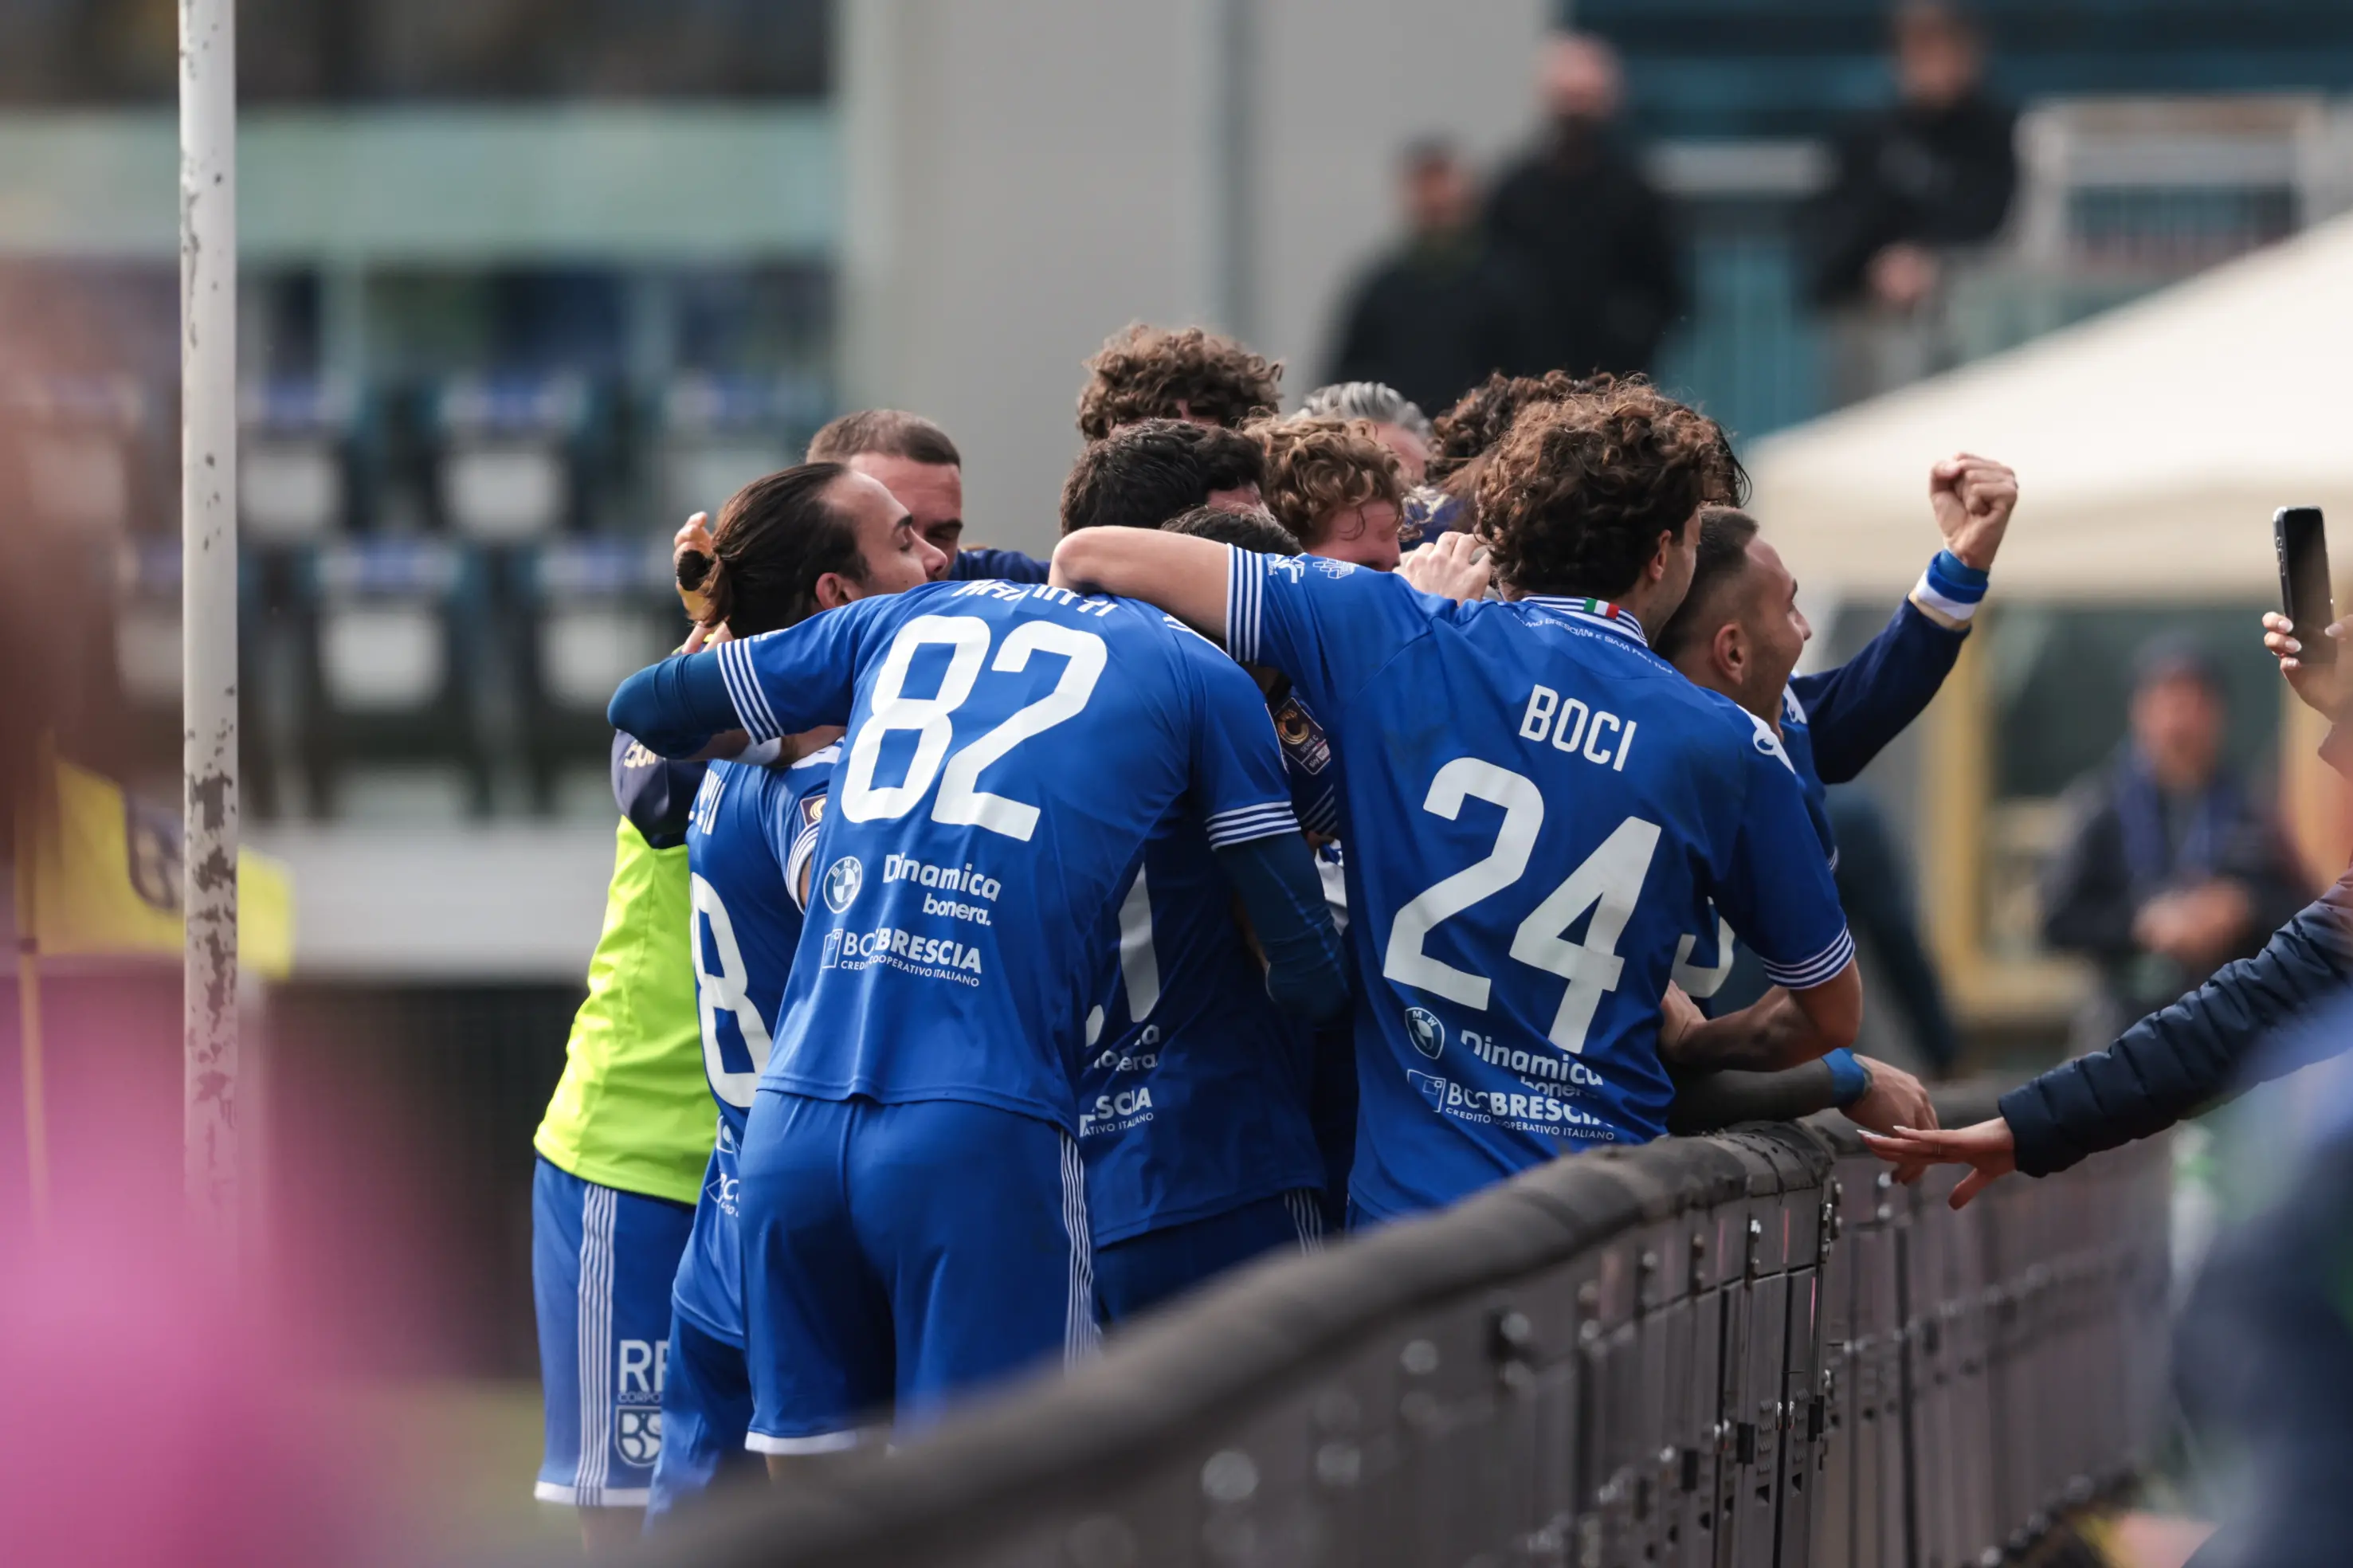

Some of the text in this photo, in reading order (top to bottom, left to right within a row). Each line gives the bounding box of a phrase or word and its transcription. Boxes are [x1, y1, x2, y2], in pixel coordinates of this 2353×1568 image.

[841, 614, 1108, 842] 82
[1519, 684, 1637, 771] BOCI
[882, 851, 1002, 902] Dinamica
[1382, 757, 1661, 1054] 24
[933, 968, 980, 987] ITALIANO
[1445, 1107, 1491, 1124] CREDITO
[1563, 1127, 1615, 1141] ITALIANO
